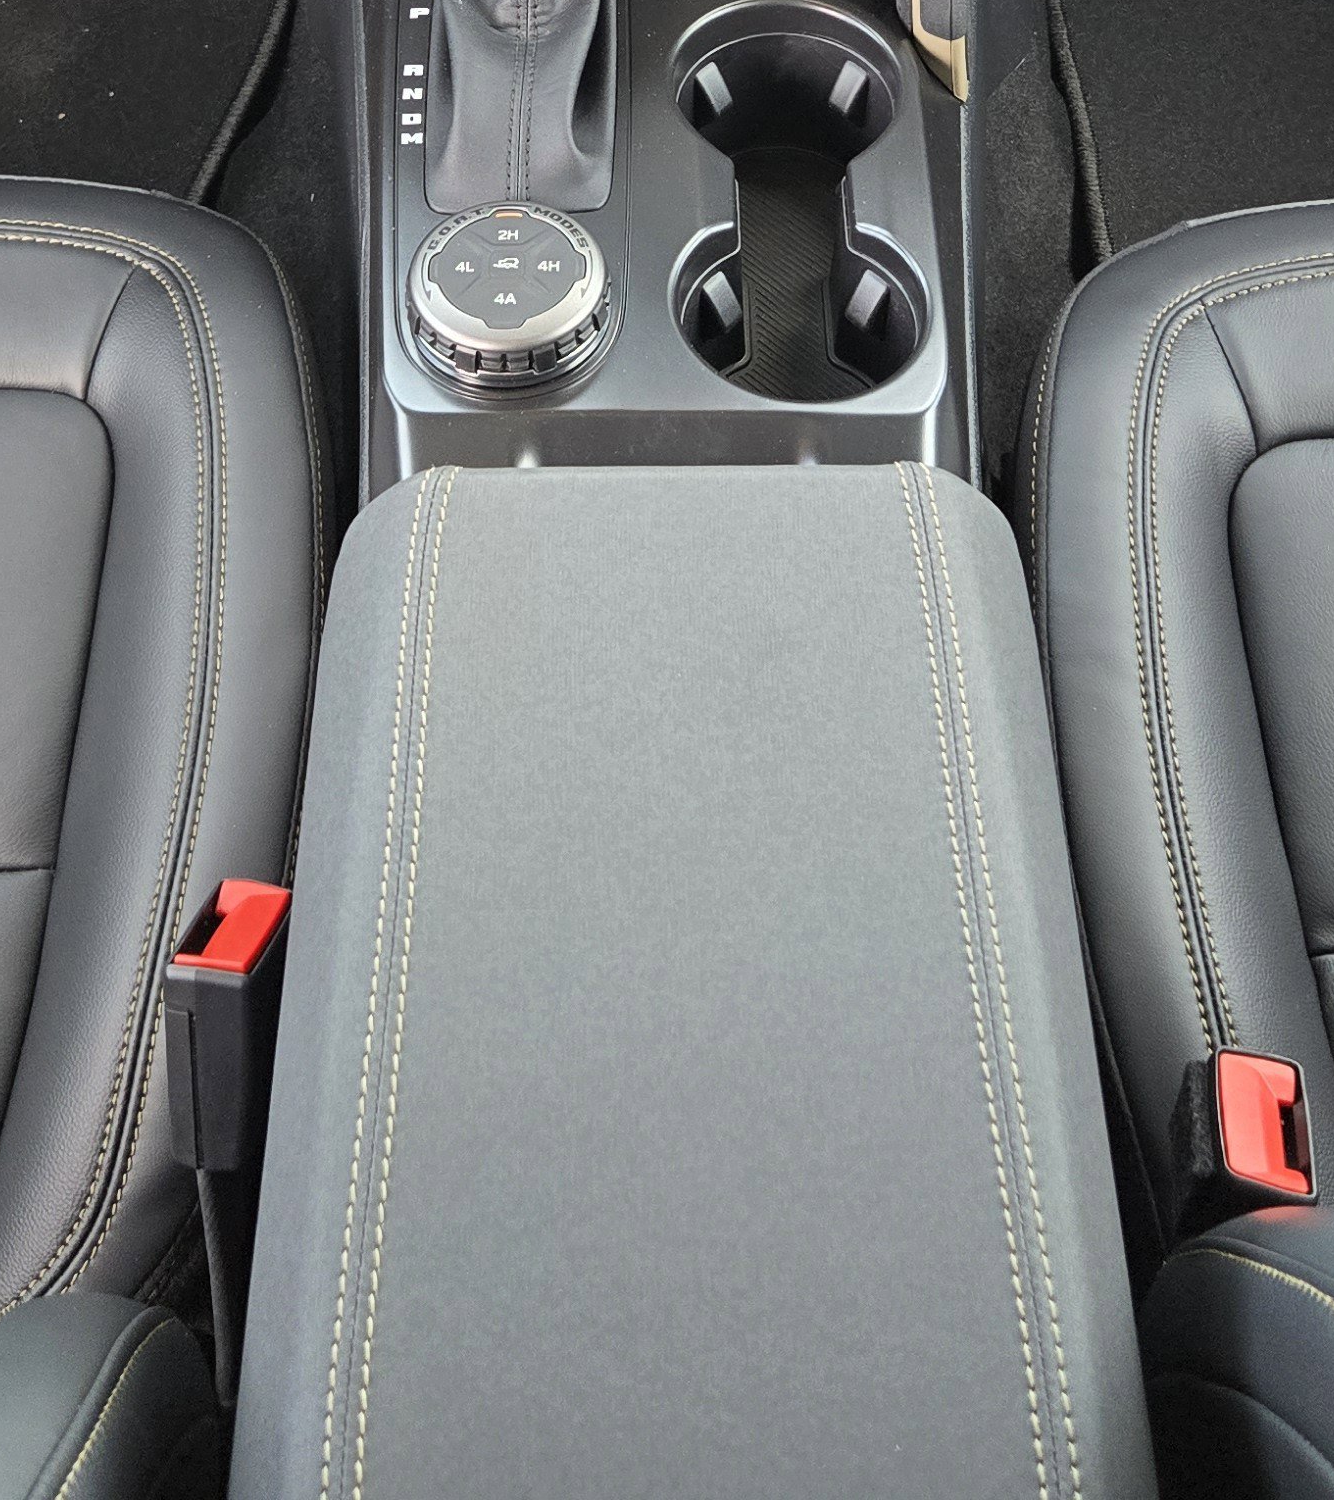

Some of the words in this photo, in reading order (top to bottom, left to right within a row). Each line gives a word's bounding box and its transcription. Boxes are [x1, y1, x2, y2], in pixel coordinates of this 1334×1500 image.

[409, 7, 430, 20] P
[403, 64, 424, 77] R
[402, 87, 423, 100] N
[402, 113, 422, 126] D
[400, 132, 423, 145] M
[533, 206, 589, 249] MODES
[497, 229, 519, 241] 2H
[454, 261, 475, 273] 4L
[537, 260, 560, 273] 4H
[494, 293, 517, 305] 4A
